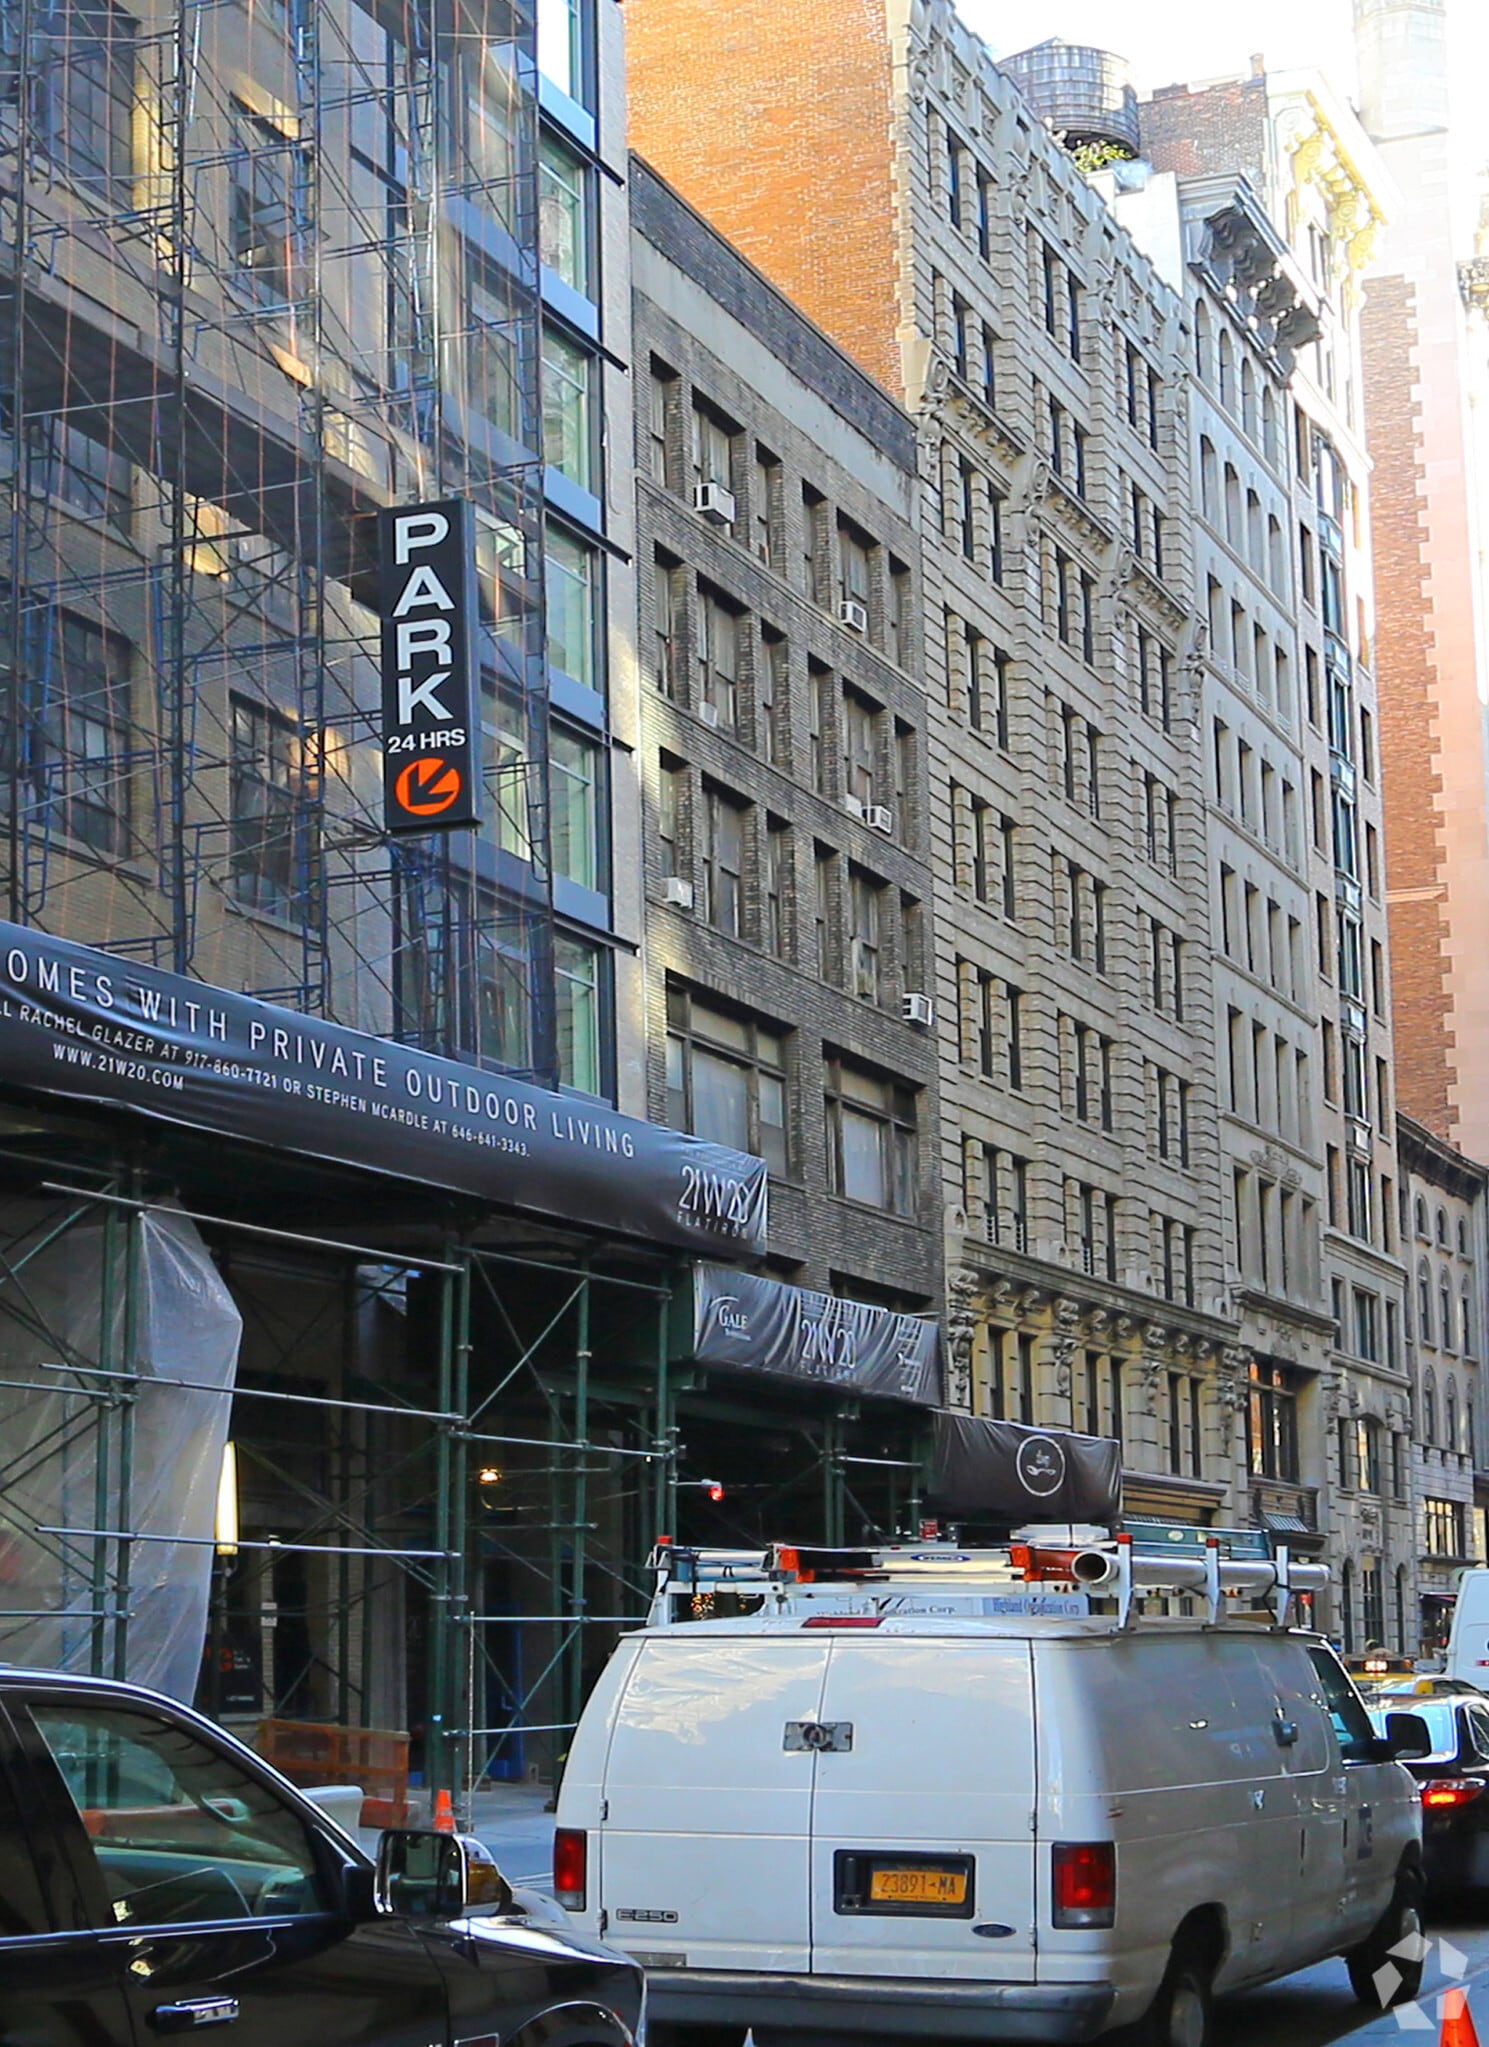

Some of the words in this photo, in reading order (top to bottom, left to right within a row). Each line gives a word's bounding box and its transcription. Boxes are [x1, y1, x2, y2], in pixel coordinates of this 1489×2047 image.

[392, 511, 456, 725] PARK
[388, 735, 417, 754] 24
[420, 728, 466, 750] HRS
[0, 1000, 12, 1018] L
[20, 1004, 88, 1037] RACHEL
[91, 1024, 155, 1054] GLAZER
[160, 1043, 180, 1061] AT
[184, 1050, 277, 1089] 917-860-7721
[282, 1077, 302, 1095] OR
[306, 1083, 367, 1113] STEPHEN
[371, 1101, 429, 1130] MCARDLE
[432, 1119, 448, 1135] AT
[6, 948, 114, 1009] OMES
[138, 986, 228, 1042] WITH
[249, 1020, 388, 1088] PRIVATE
[405, 1068, 538, 1132] OUTDOOR
[551, 1111, 635, 1159] LIVING
[52, 1042, 184, 1091] WWW.21W20.COM
[617, 1909, 679, 1923] E250
